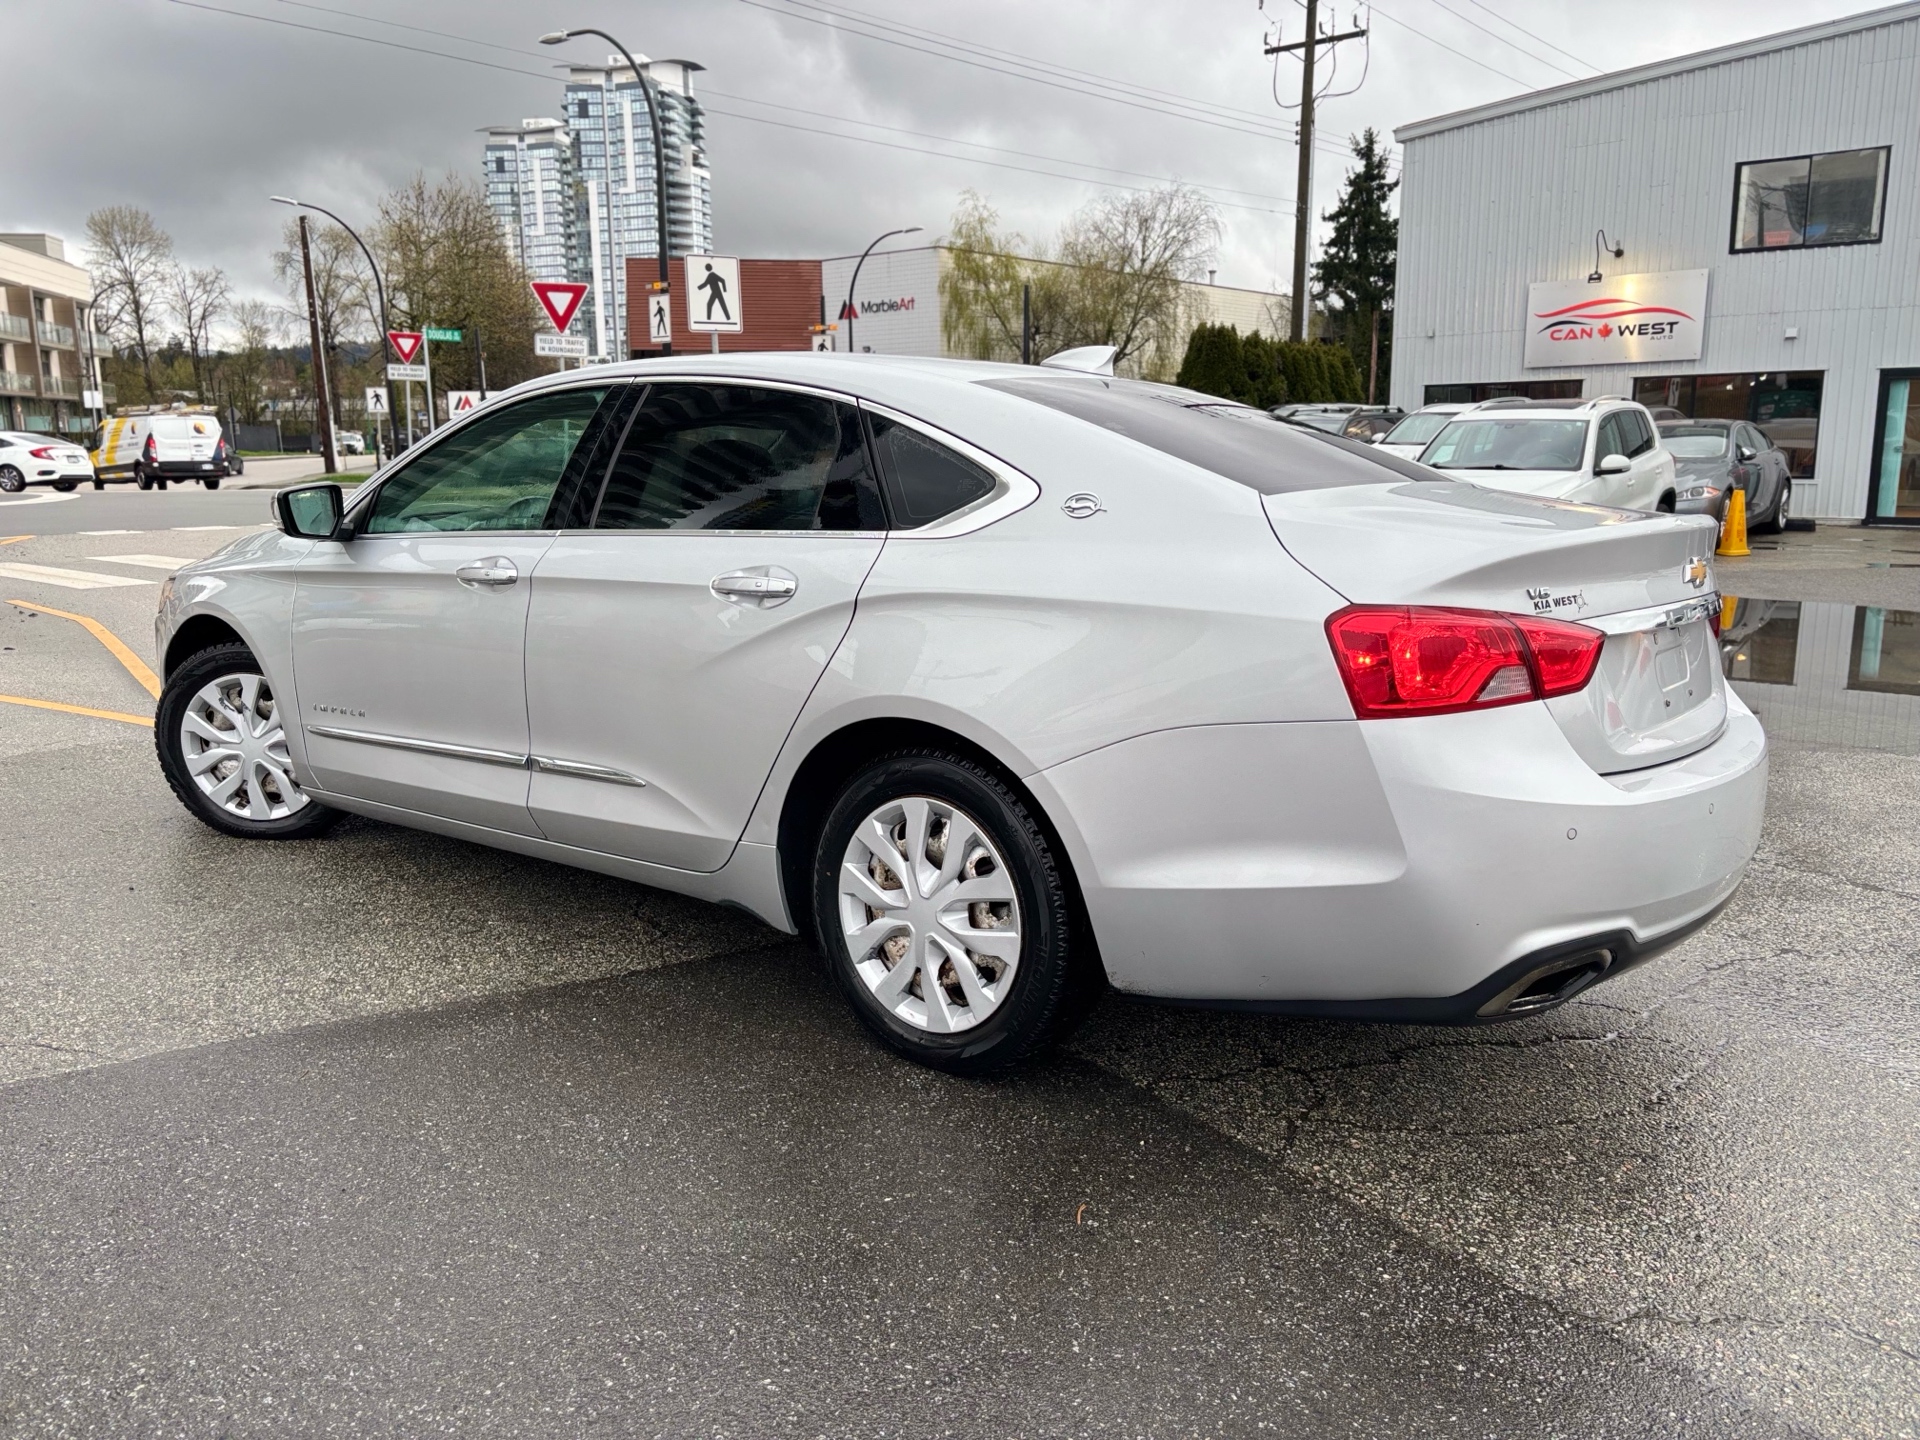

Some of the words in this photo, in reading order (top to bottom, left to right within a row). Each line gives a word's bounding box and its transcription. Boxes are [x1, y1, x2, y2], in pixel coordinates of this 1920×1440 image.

[861, 297, 915, 313] MarbleArt
[428, 330, 452, 340] DOUGLAS
[1550, 327, 1593, 341] CAN
[1618, 321, 1680, 337] WEST
[548, 346, 585, 354] ROUNDABOUT
[565, 339, 585, 347] TRAFFIC
[1526, 587, 1551, 601] V6
[1533, 599, 1552, 611] KIA
[1552, 594, 1578, 608] WEST
[313, 703, 366, 718] IMPALA
